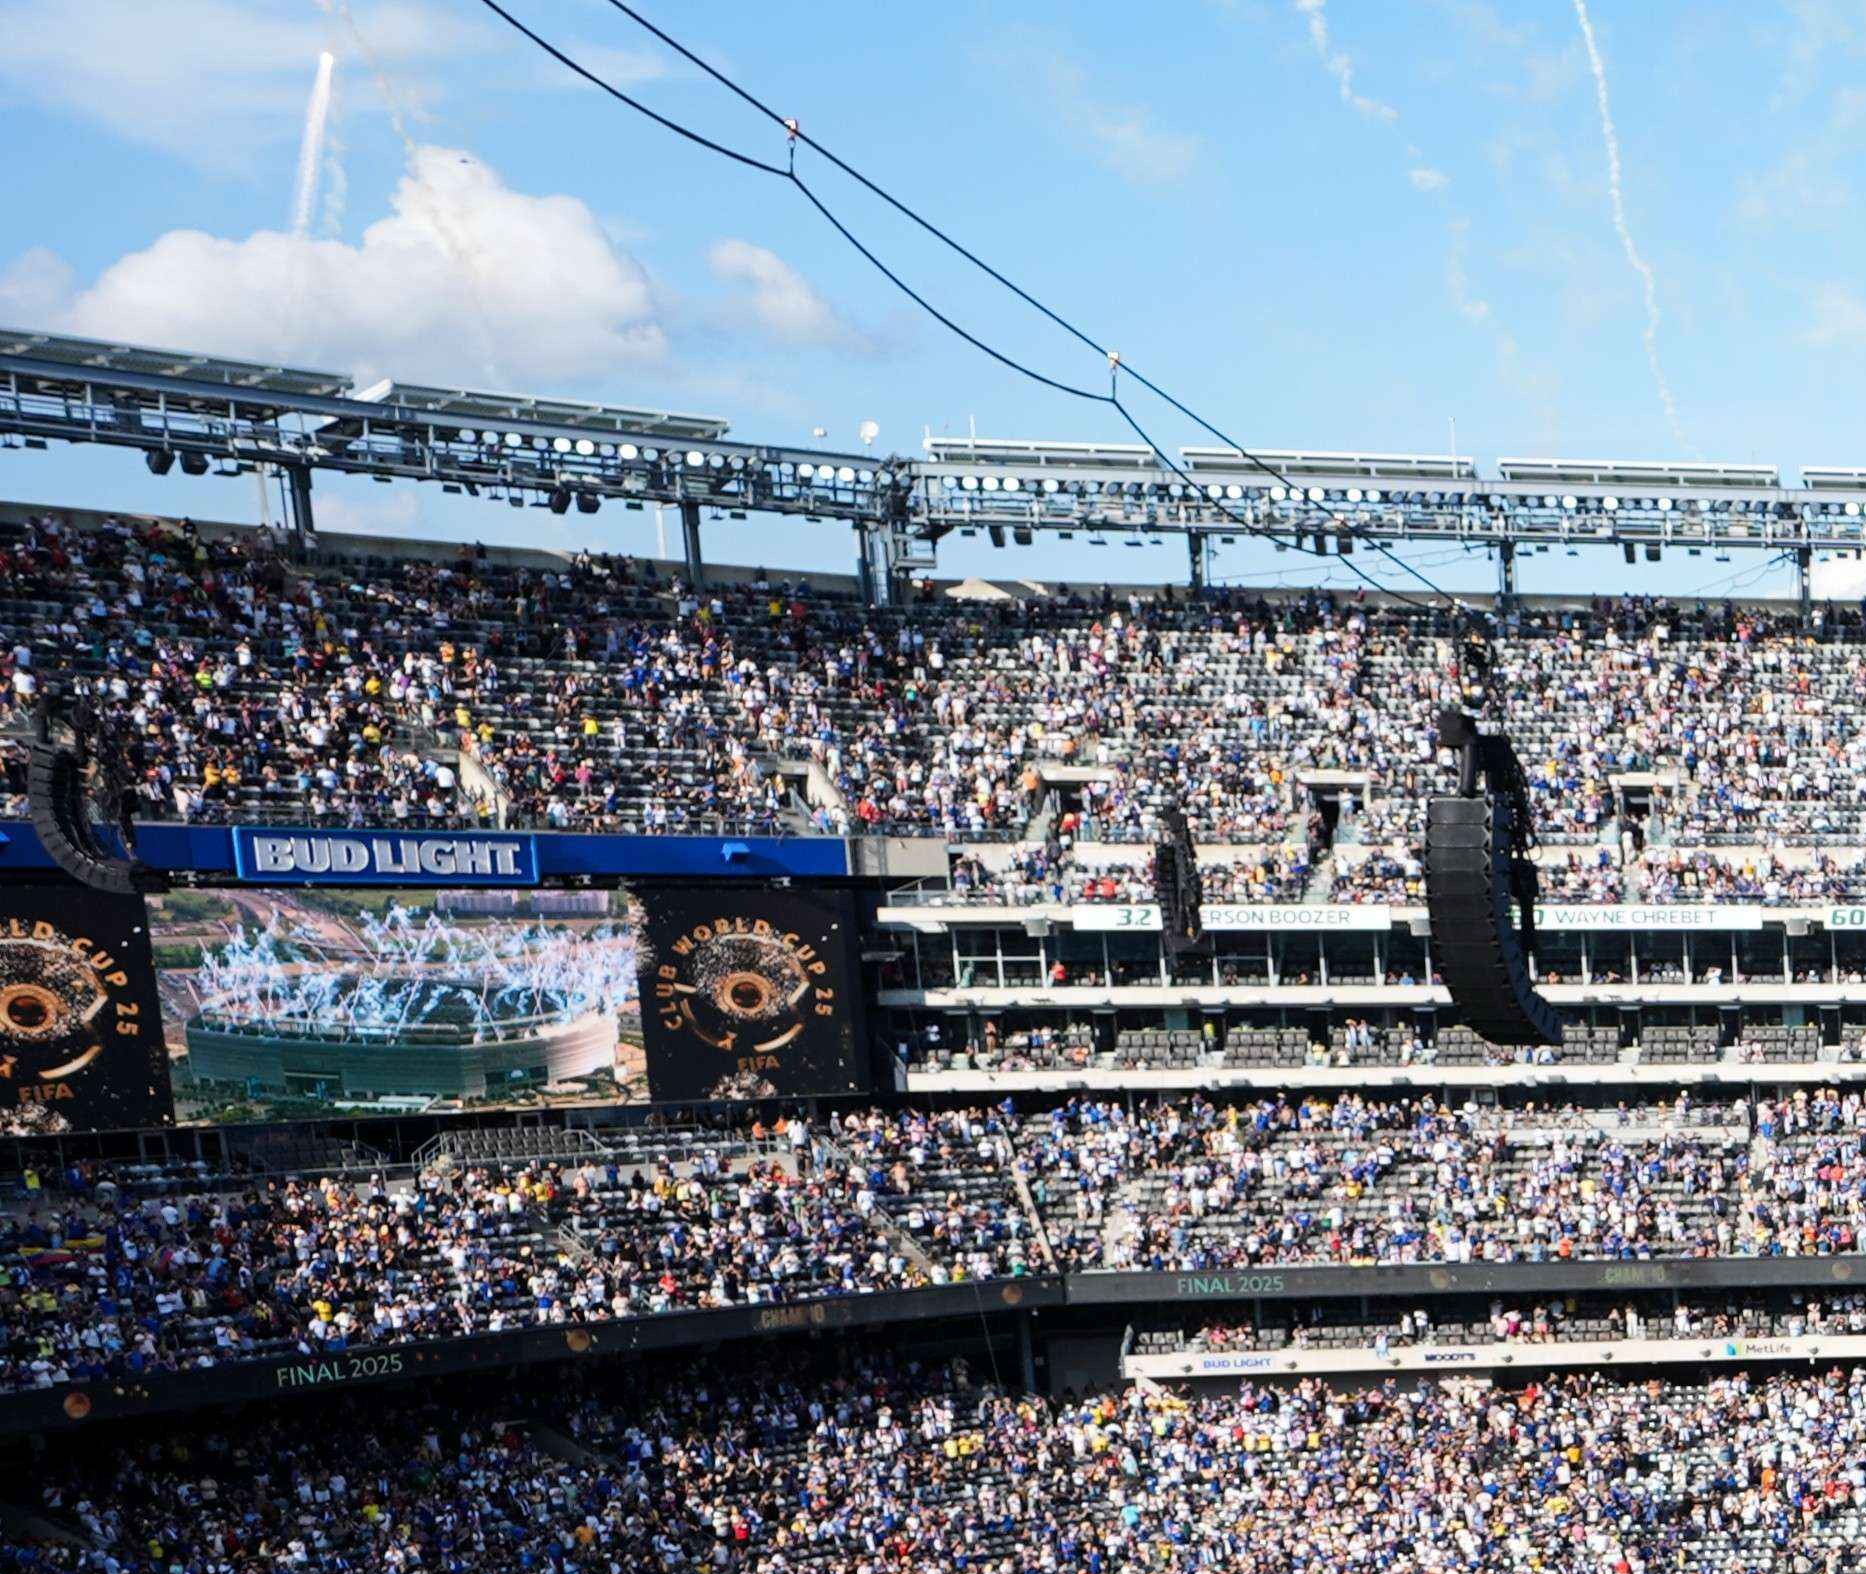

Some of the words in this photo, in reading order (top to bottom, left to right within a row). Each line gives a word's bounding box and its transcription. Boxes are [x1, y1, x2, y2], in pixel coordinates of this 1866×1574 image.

[253, 834, 371, 873] BUD
[374, 839, 520, 875] LIGHT
[1270, 910, 1349, 924] BOOZER
[1555, 909, 1623, 923] WAYNE
[1630, 909, 1716, 923] CHREBET
[1832, 908, 1865, 924] 60
[671, 917, 771, 955] WORLD
[782, 932, 826, 974] CUP
[72, 937, 128, 987] CUP
[116, 1001, 140, 1036] 25
[18, 1082, 75, 1102] FIFA
[1178, 1277, 1233, 1292] FINAL
[1239, 1276, 1284, 1291] 2025
[1746, 1343, 1791, 1354] MetLife
[277, 1361, 345, 1388] FINAL
[351, 1354, 403, 1378] 2025
